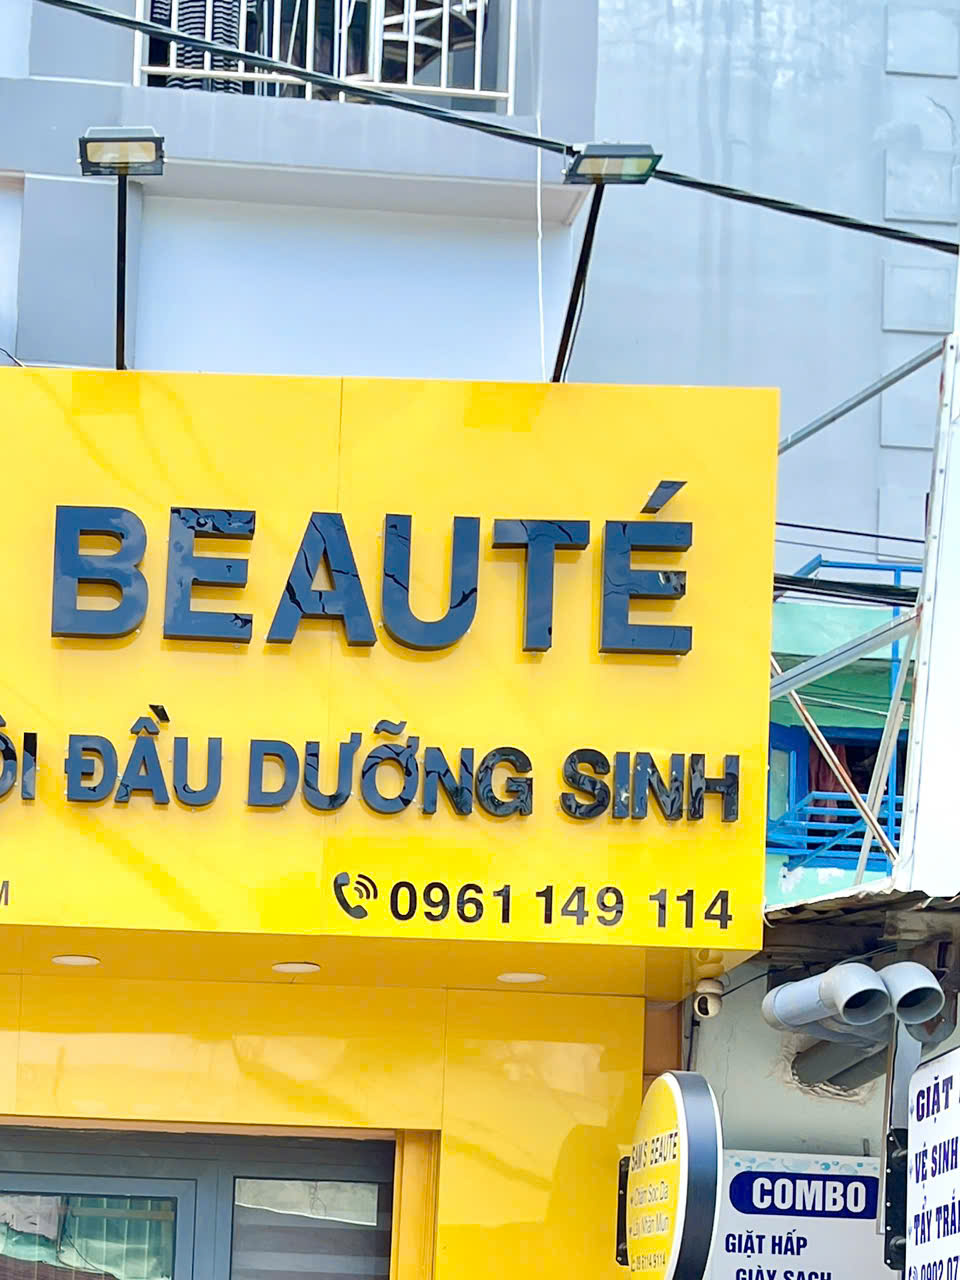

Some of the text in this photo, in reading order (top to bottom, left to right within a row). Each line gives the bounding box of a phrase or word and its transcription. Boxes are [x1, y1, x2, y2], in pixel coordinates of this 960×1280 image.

[50, 480, 694, 655] BEAUTÉ
[65, 704, 223, 807] ĐẦU
[247, 719, 534, 817] DƯỠNG
[559, 748, 739, 823] SINH
[390, 880, 733, 930] 0961 149 114
[916, 1075, 954, 1123] GIẶT
[930, 1136, 959, 1179] SINH
[752, 1177, 867, 1214] COMBO
[725, 1229, 808, 1258] GIẶT HẤP
